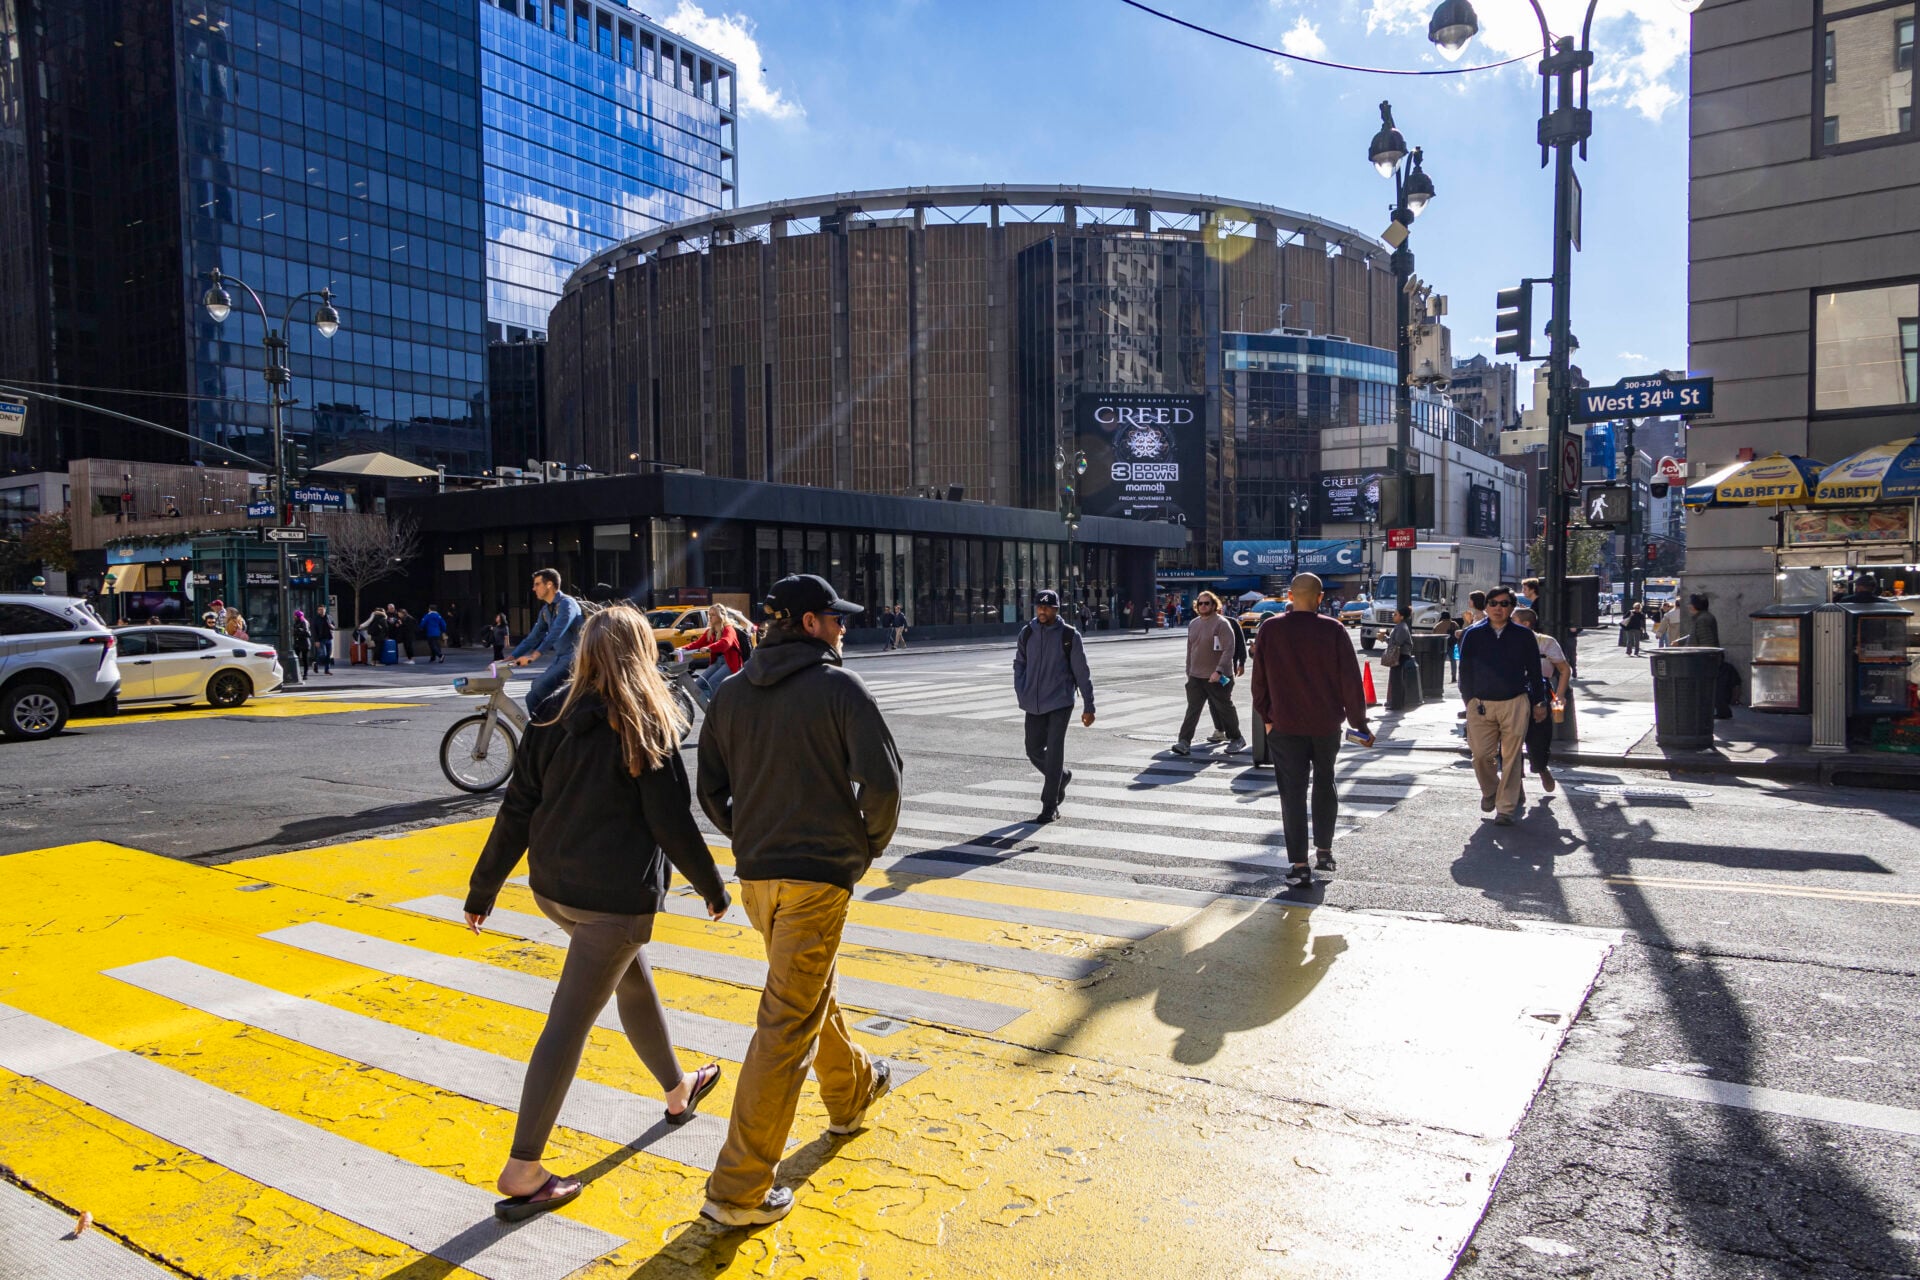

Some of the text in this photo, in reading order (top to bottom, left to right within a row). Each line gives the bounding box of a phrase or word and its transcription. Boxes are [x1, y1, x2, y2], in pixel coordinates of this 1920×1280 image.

[1646, 380, 1661, 388] 370
[1588, 388, 1699, 412] West 34th St
[0, 413, 20, 421] ONLY
[1094, 406, 1194, 429] CREED
[1111, 462, 1131, 481] 3
[1126, 482, 1165, 491] mammoth
[1322, 477, 1364, 488] CREED
[295, 490, 340, 501] Eighth Ave
[1721, 484, 1799, 497] SABRETT
[1818, 486, 1879, 499] SABRETT
